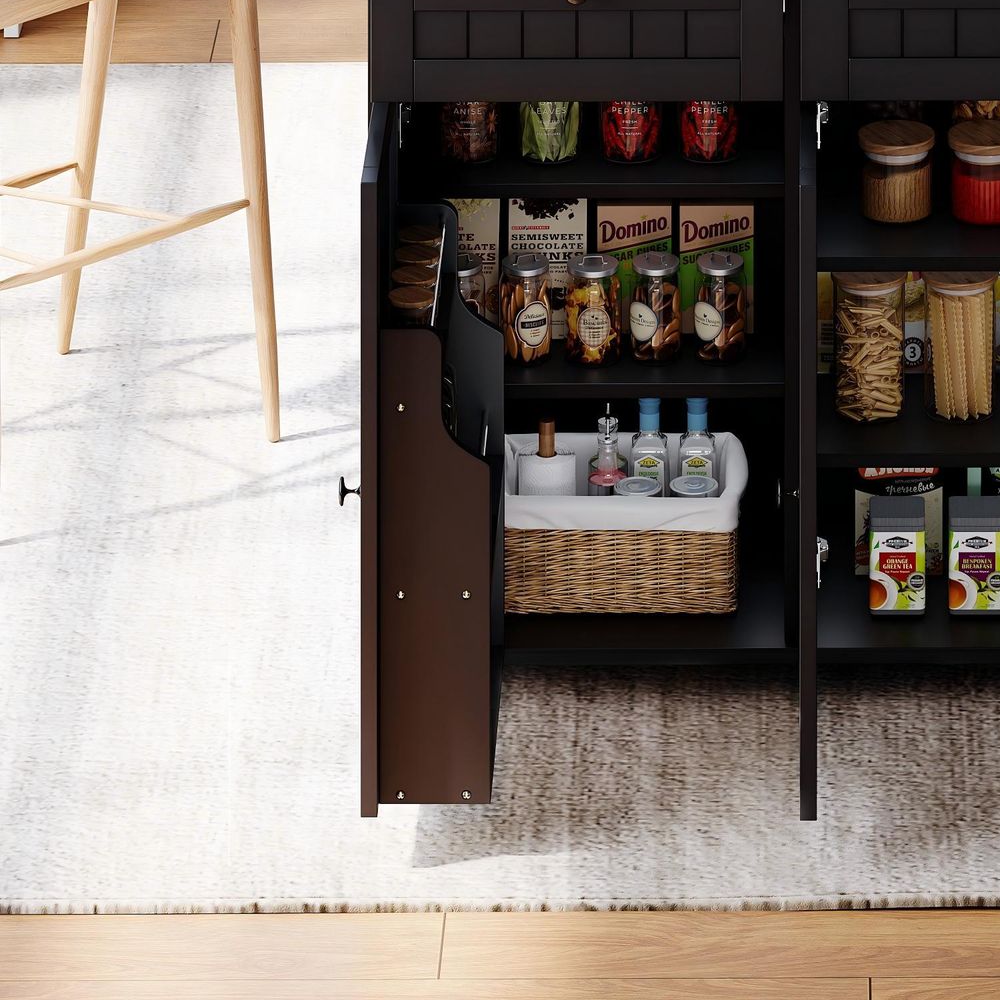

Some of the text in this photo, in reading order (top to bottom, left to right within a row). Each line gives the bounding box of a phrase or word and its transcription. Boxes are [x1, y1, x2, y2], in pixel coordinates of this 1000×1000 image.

[612, 106, 648, 115] PEPPER
[691, 106, 728, 115] PEPPER
[599, 216, 668, 244] Domino
[682, 216, 750, 243] Domino
[909, 346, 916, 358] 3
